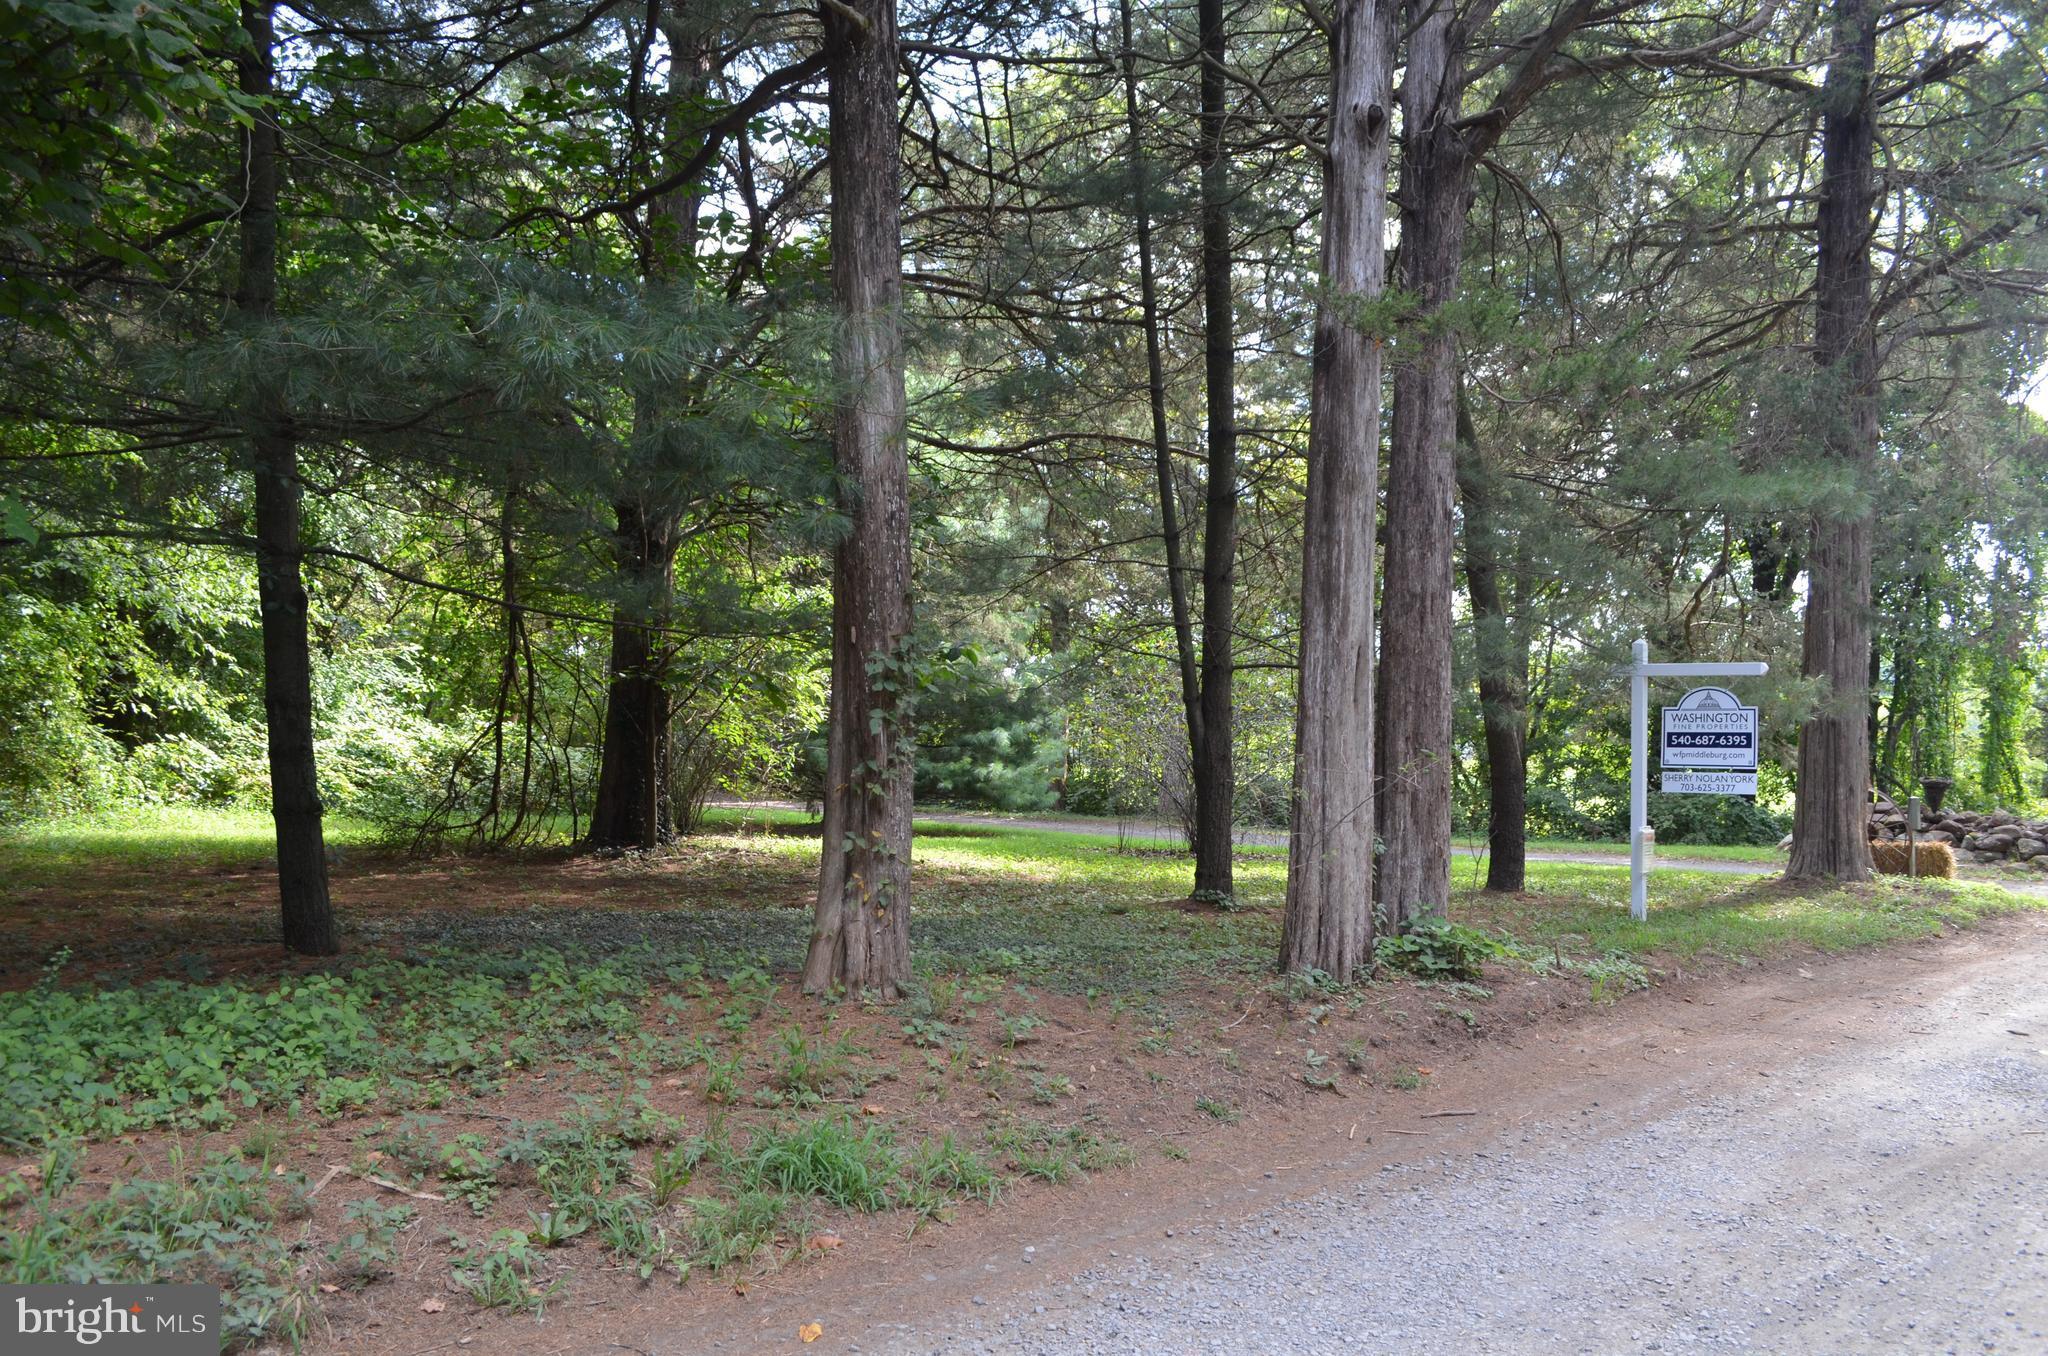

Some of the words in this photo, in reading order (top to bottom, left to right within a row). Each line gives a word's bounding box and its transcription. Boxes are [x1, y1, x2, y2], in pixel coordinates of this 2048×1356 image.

[1671, 713, 1748, 723] WASHINGTON
[1671, 735, 1747, 745] 540-687-6395
[1673, 751, 1745, 760] wfpmiddleburg.com
[1664, 774, 1692, 782] SHERRY
[1696, 775, 1728, 783] NOLAN
[1728, 775, 1754, 783] YORK
[1680, 783, 1736, 792] 703-625-3377
